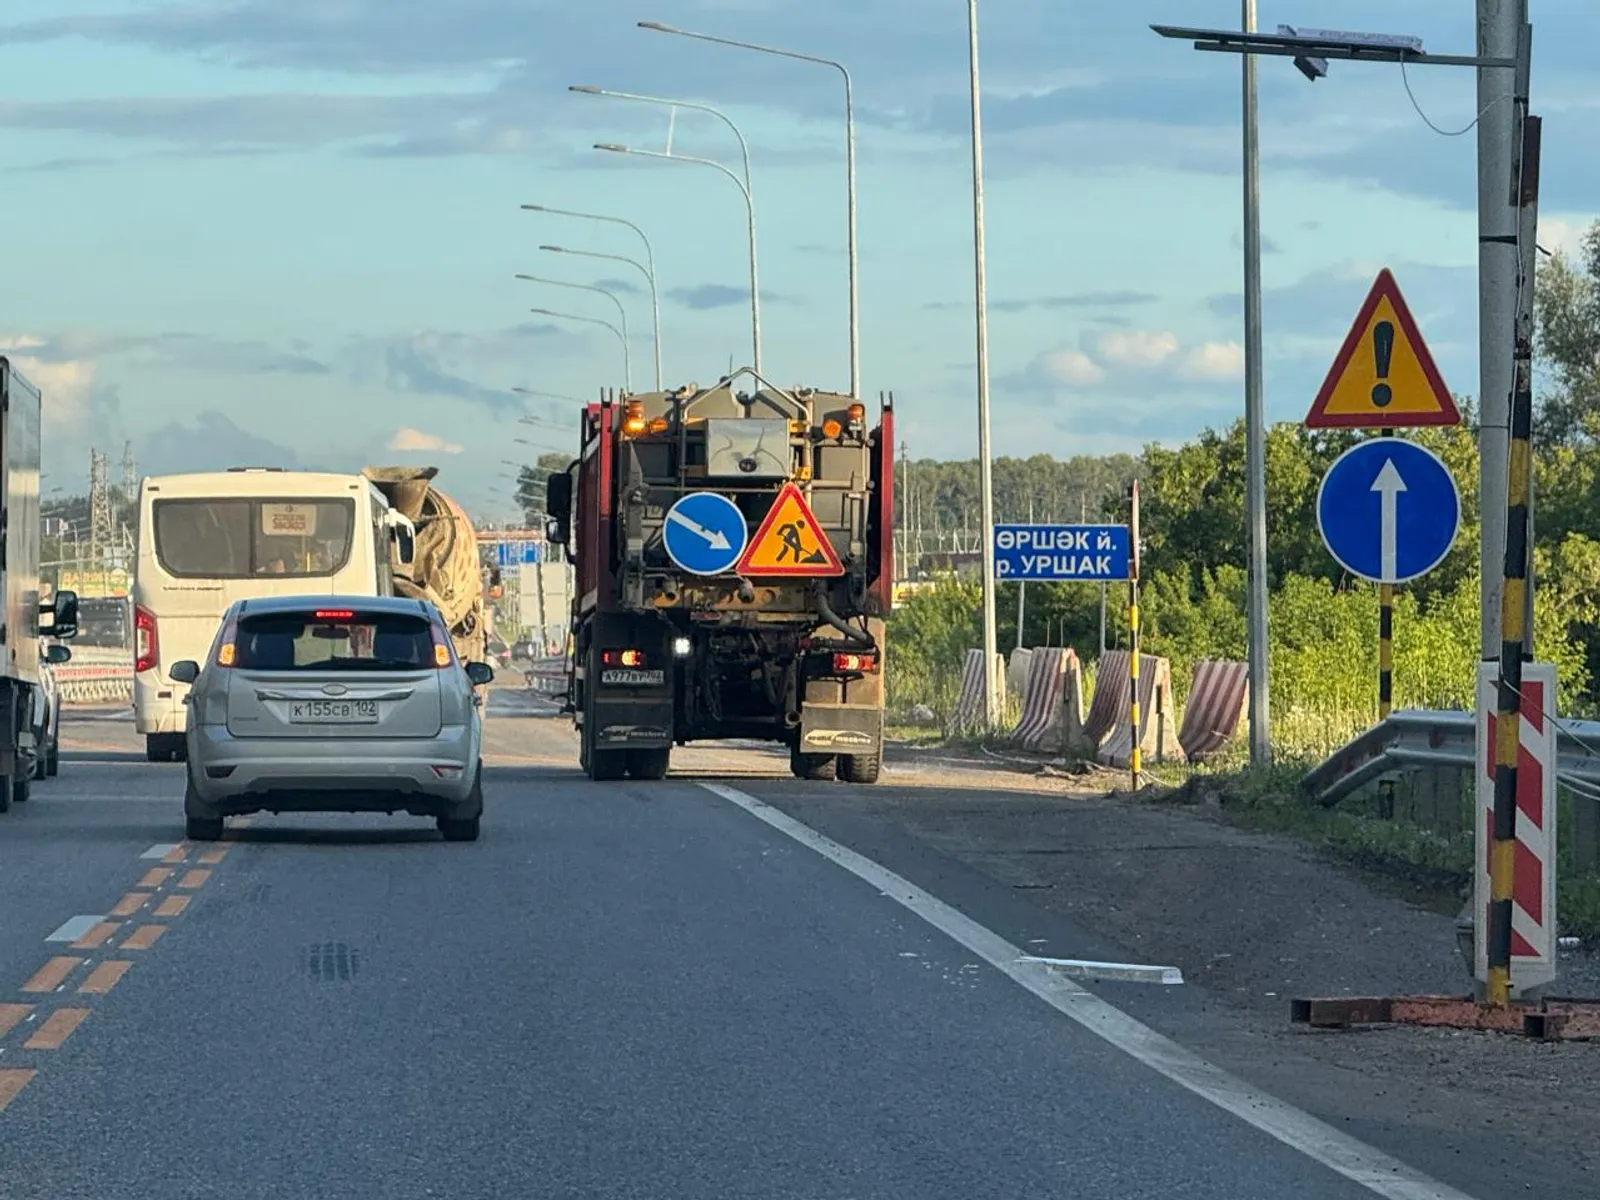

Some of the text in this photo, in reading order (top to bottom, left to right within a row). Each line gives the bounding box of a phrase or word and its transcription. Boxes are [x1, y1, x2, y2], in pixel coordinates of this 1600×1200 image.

[996, 531, 1117, 550] ӨРШӘК й.
[996, 555, 1111, 578] р. УРШАК
[354, 701, 376, 713] 102
